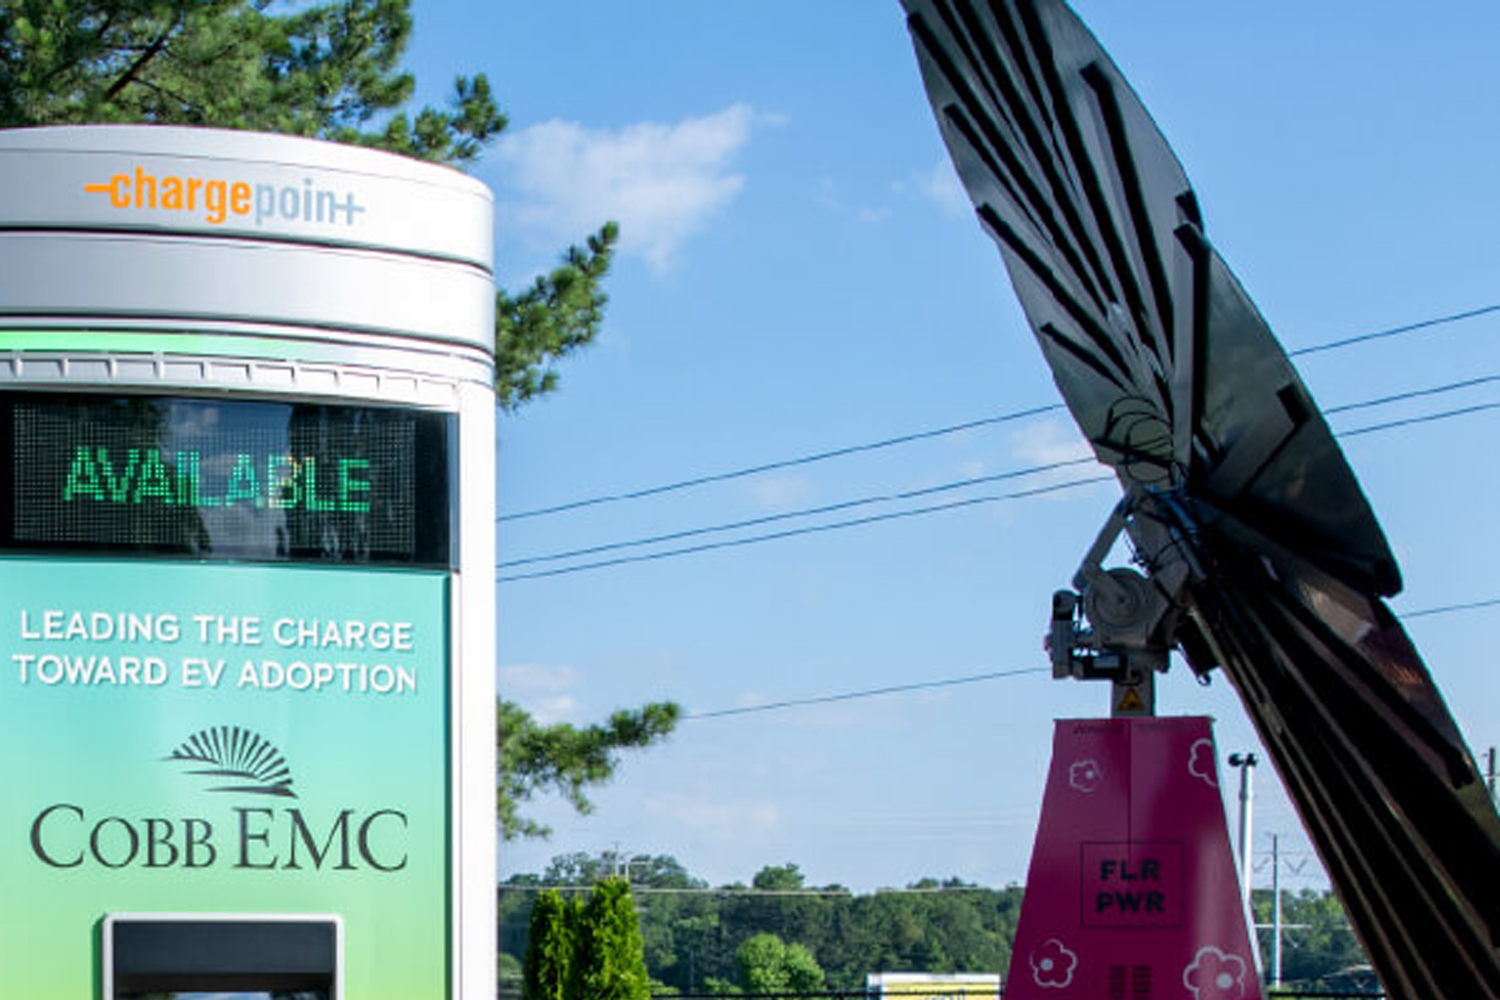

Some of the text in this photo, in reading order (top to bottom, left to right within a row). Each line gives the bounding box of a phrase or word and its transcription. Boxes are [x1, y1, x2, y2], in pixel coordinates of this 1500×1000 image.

[63, 446, 372, 513] AVAILABLE
[19, 609, 413, 651] LEADING THE CHARGE
[12, 653, 418, 695] TOWARD EV ADOPTION
[230, 806, 410, 873] EMC
[1101, 859, 1160, 881] FLR
[1096, 890, 1165, 914] PWR
